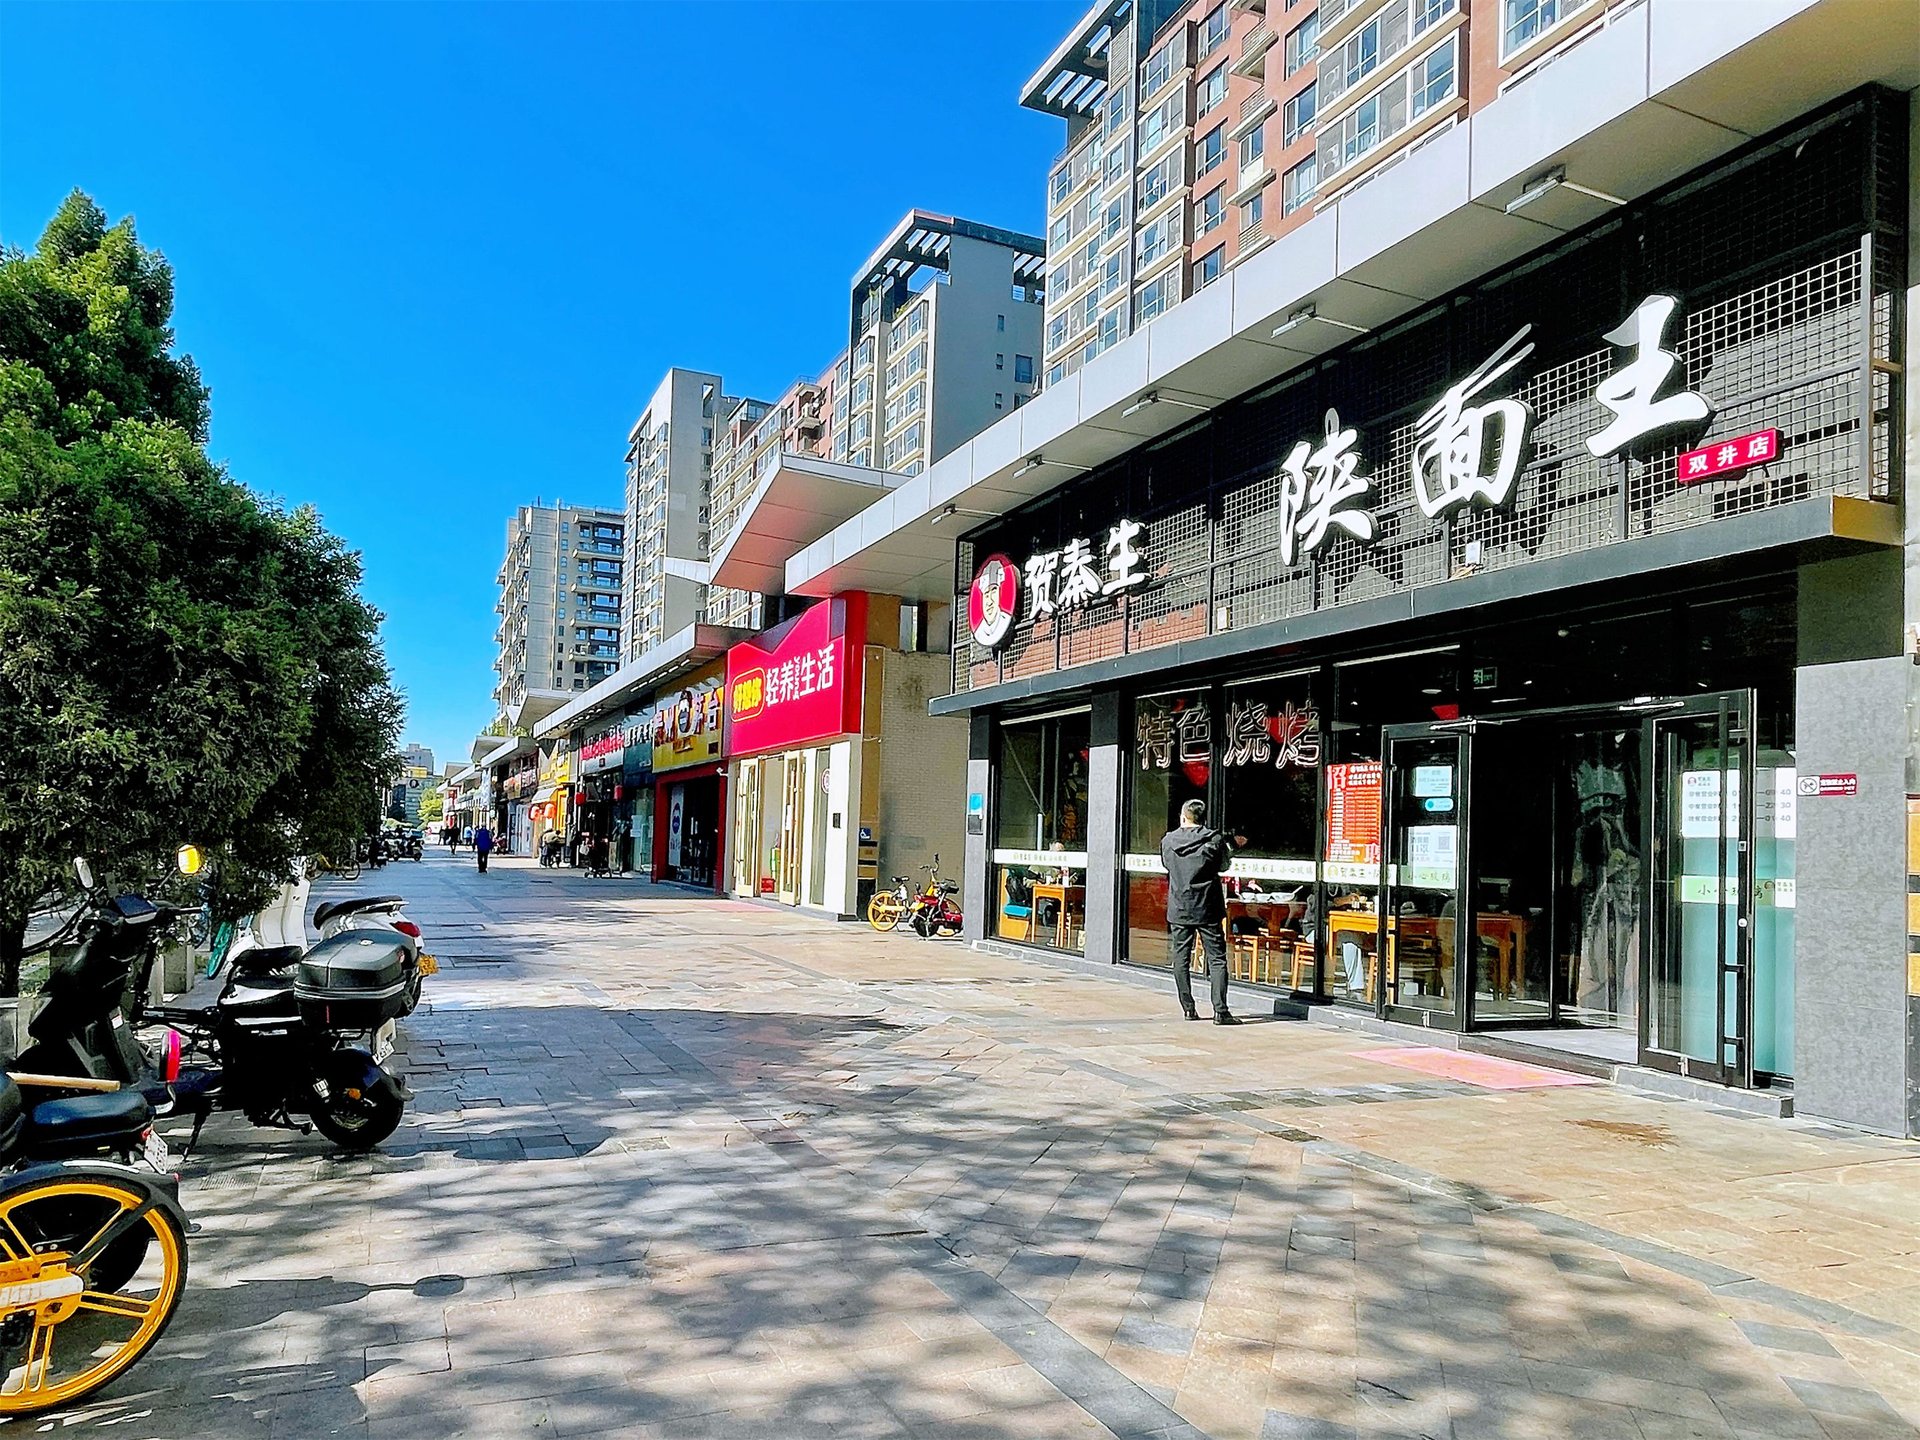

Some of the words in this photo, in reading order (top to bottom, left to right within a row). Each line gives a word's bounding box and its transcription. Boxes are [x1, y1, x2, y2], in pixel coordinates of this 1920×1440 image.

[1280, 294, 1713, 567] 陕面王
[1688, 436, 1769, 474] 双井店
[1024, 519, 1148, 620] 贺秦生
[766, 643, 834, 707] 轻养生活
[1137, 701, 1320, 770] 特色烧烤
